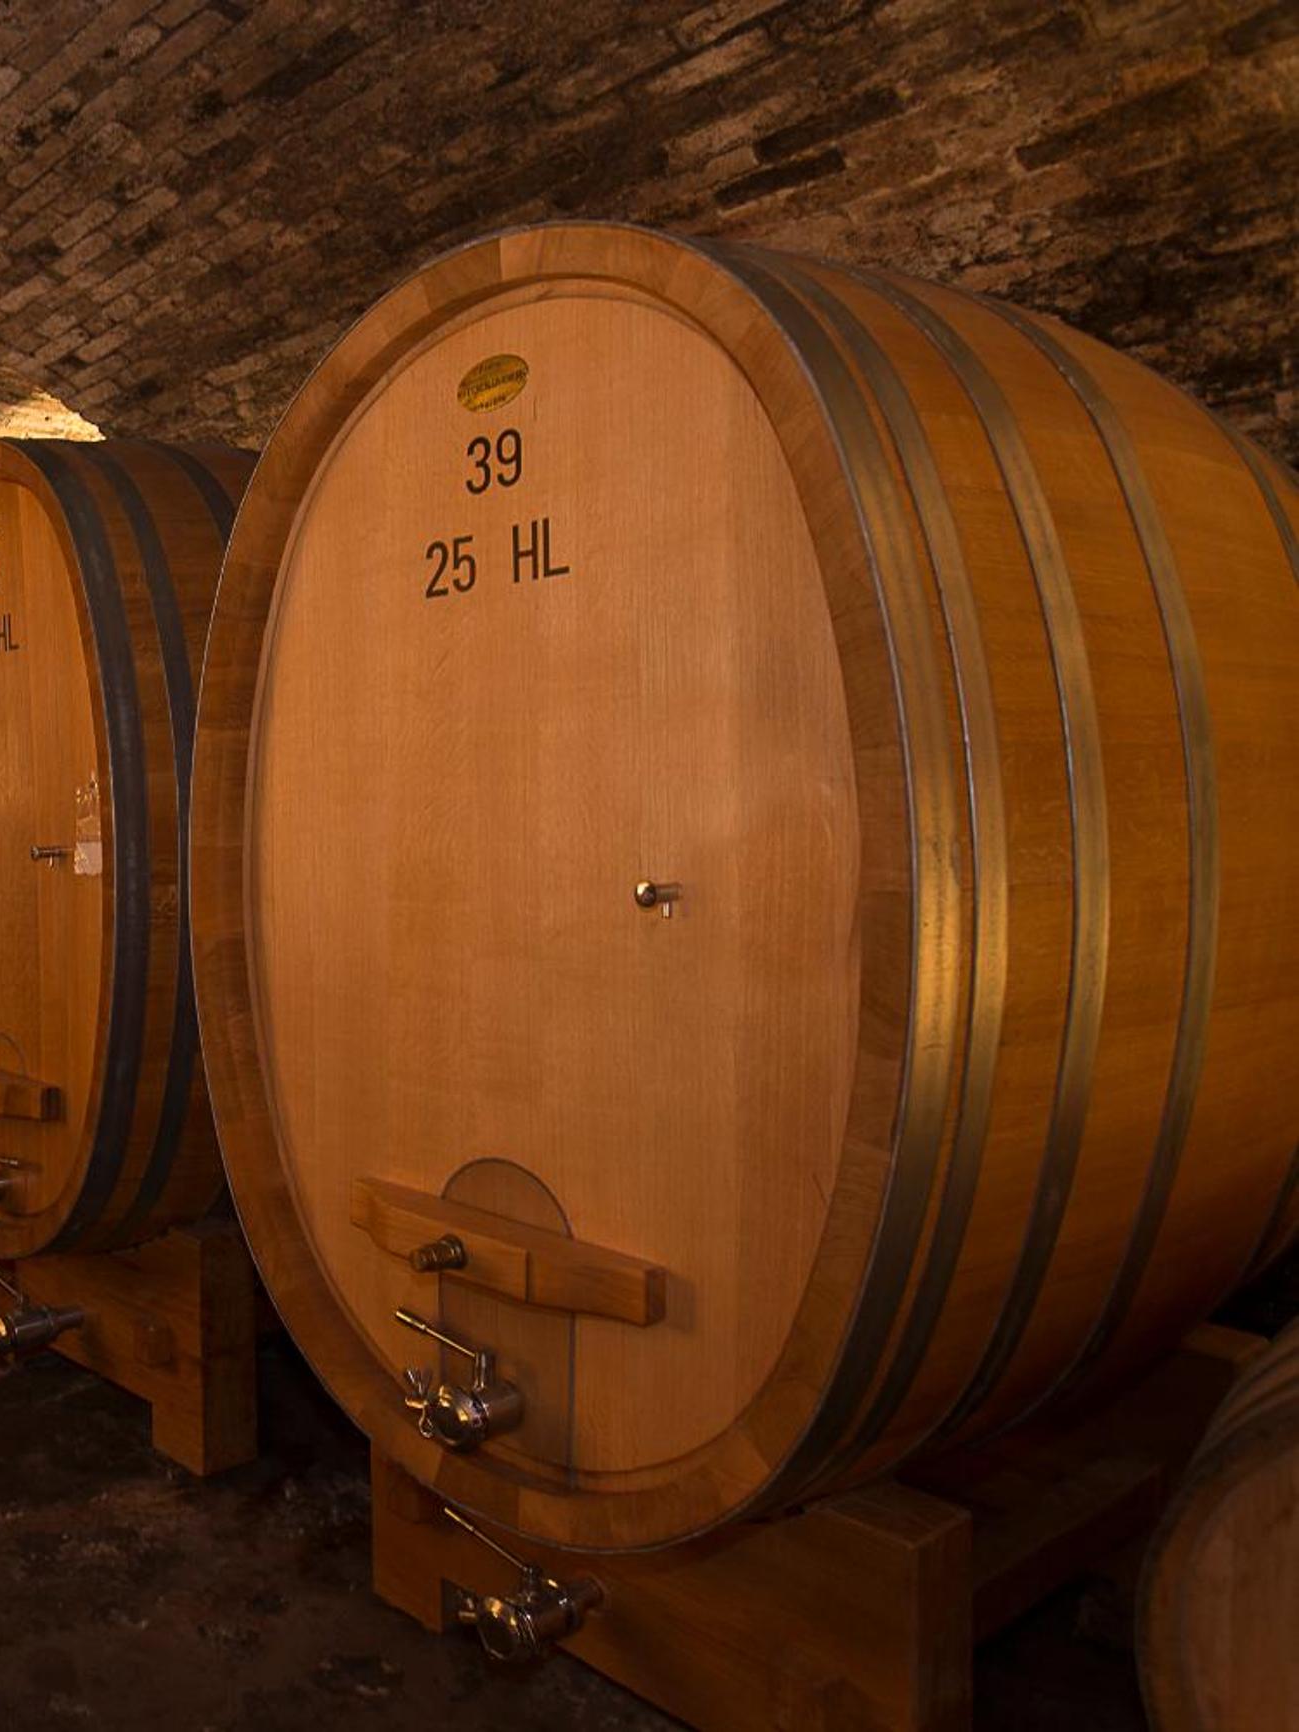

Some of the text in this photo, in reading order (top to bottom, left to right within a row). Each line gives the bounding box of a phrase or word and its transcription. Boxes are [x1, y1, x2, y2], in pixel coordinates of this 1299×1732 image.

[466, 428, 522, 495] 39
[425, 517, 570, 598] 25 HL
